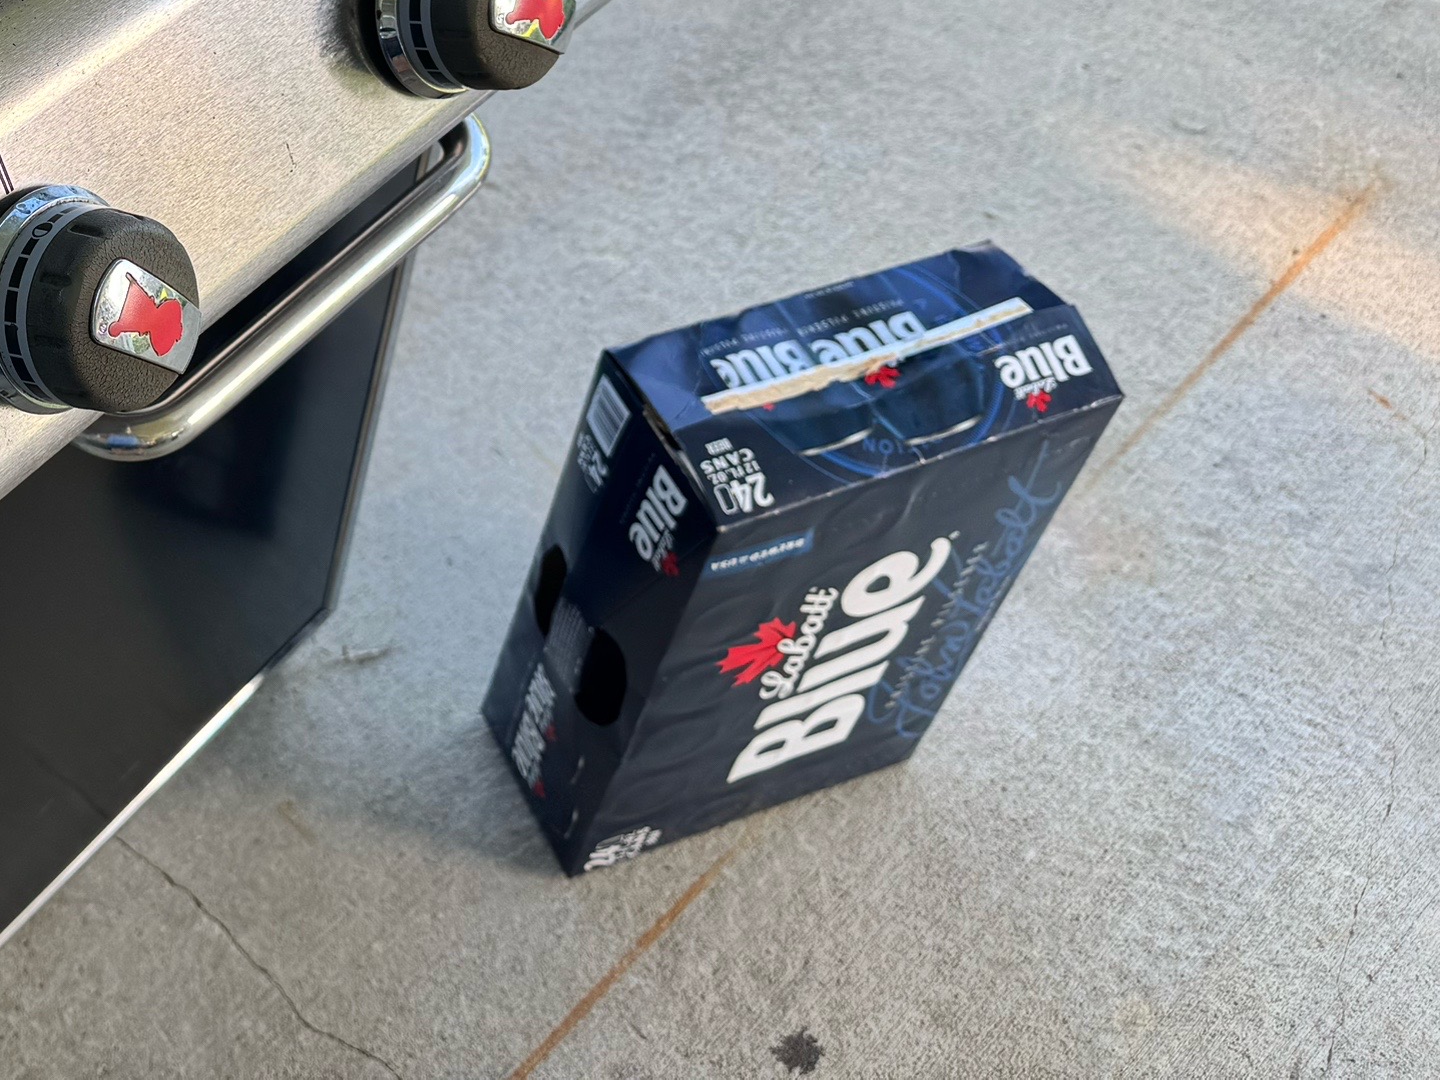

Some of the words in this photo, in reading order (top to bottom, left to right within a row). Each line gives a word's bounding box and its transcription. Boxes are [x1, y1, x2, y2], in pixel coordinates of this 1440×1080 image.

[994, 333, 1094, 389] Blue
[700, 447, 755, 472] CANS
[628, 464, 689, 562] Blue
[726, 536, 953, 784] Blue
[758, 585, 840, 700] Labatt
